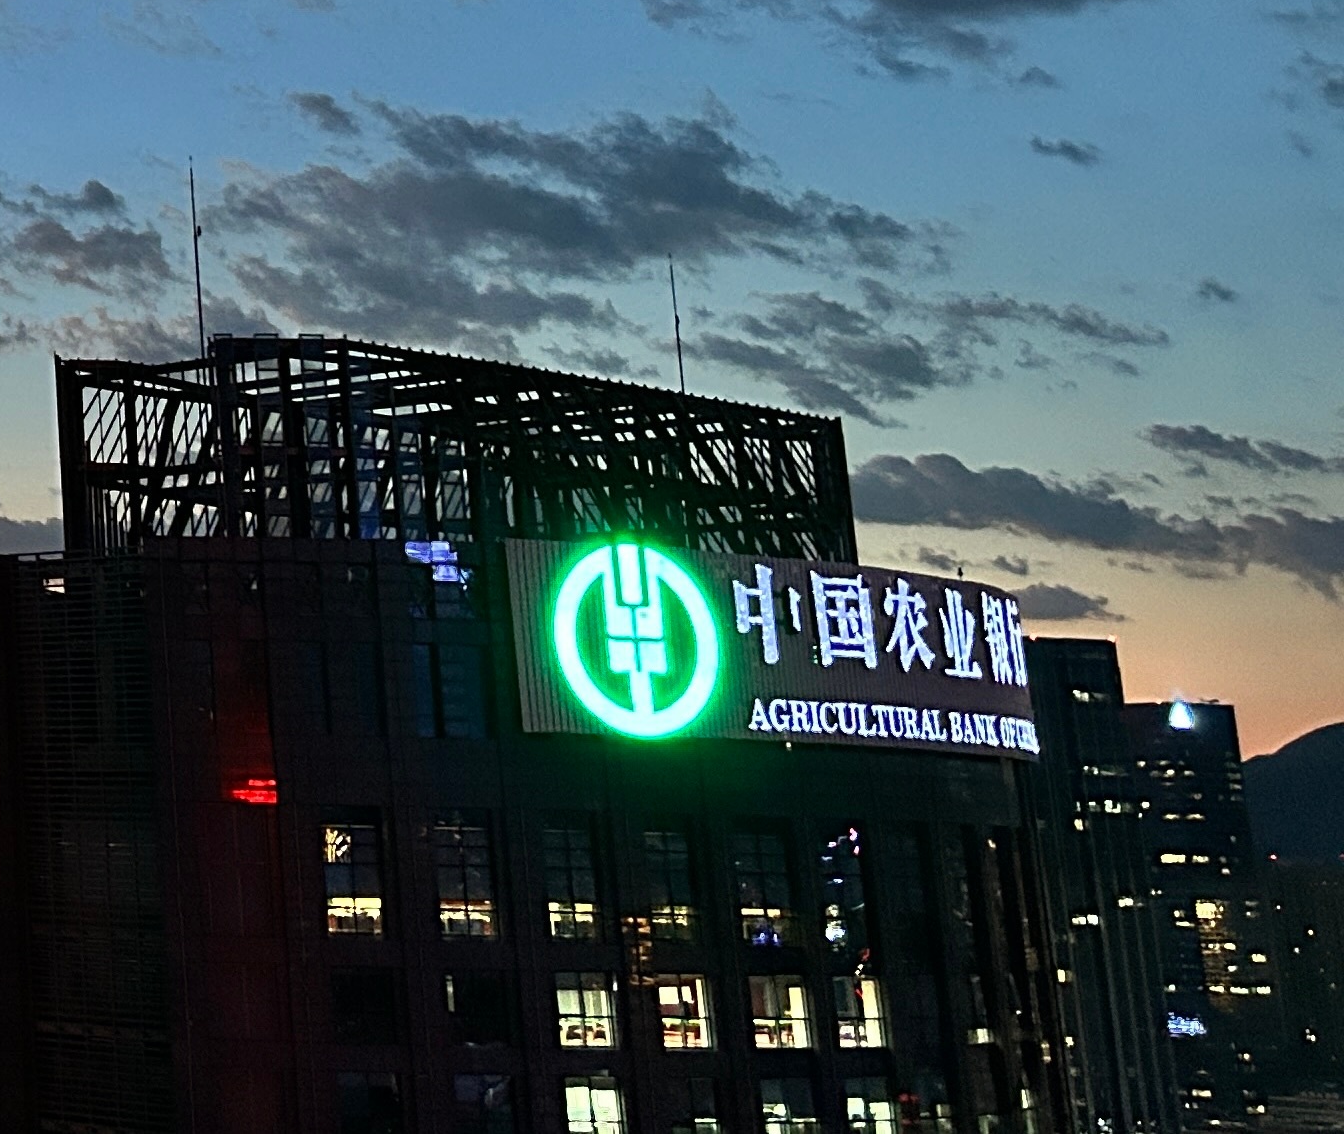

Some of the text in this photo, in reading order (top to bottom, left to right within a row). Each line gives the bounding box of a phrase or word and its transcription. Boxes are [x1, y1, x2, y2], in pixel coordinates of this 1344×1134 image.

[748, 698, 948, 742] AGRICULTURAL
[948, 712, 1000, 747] BANK
[1000, 716, 1017, 749] OF
